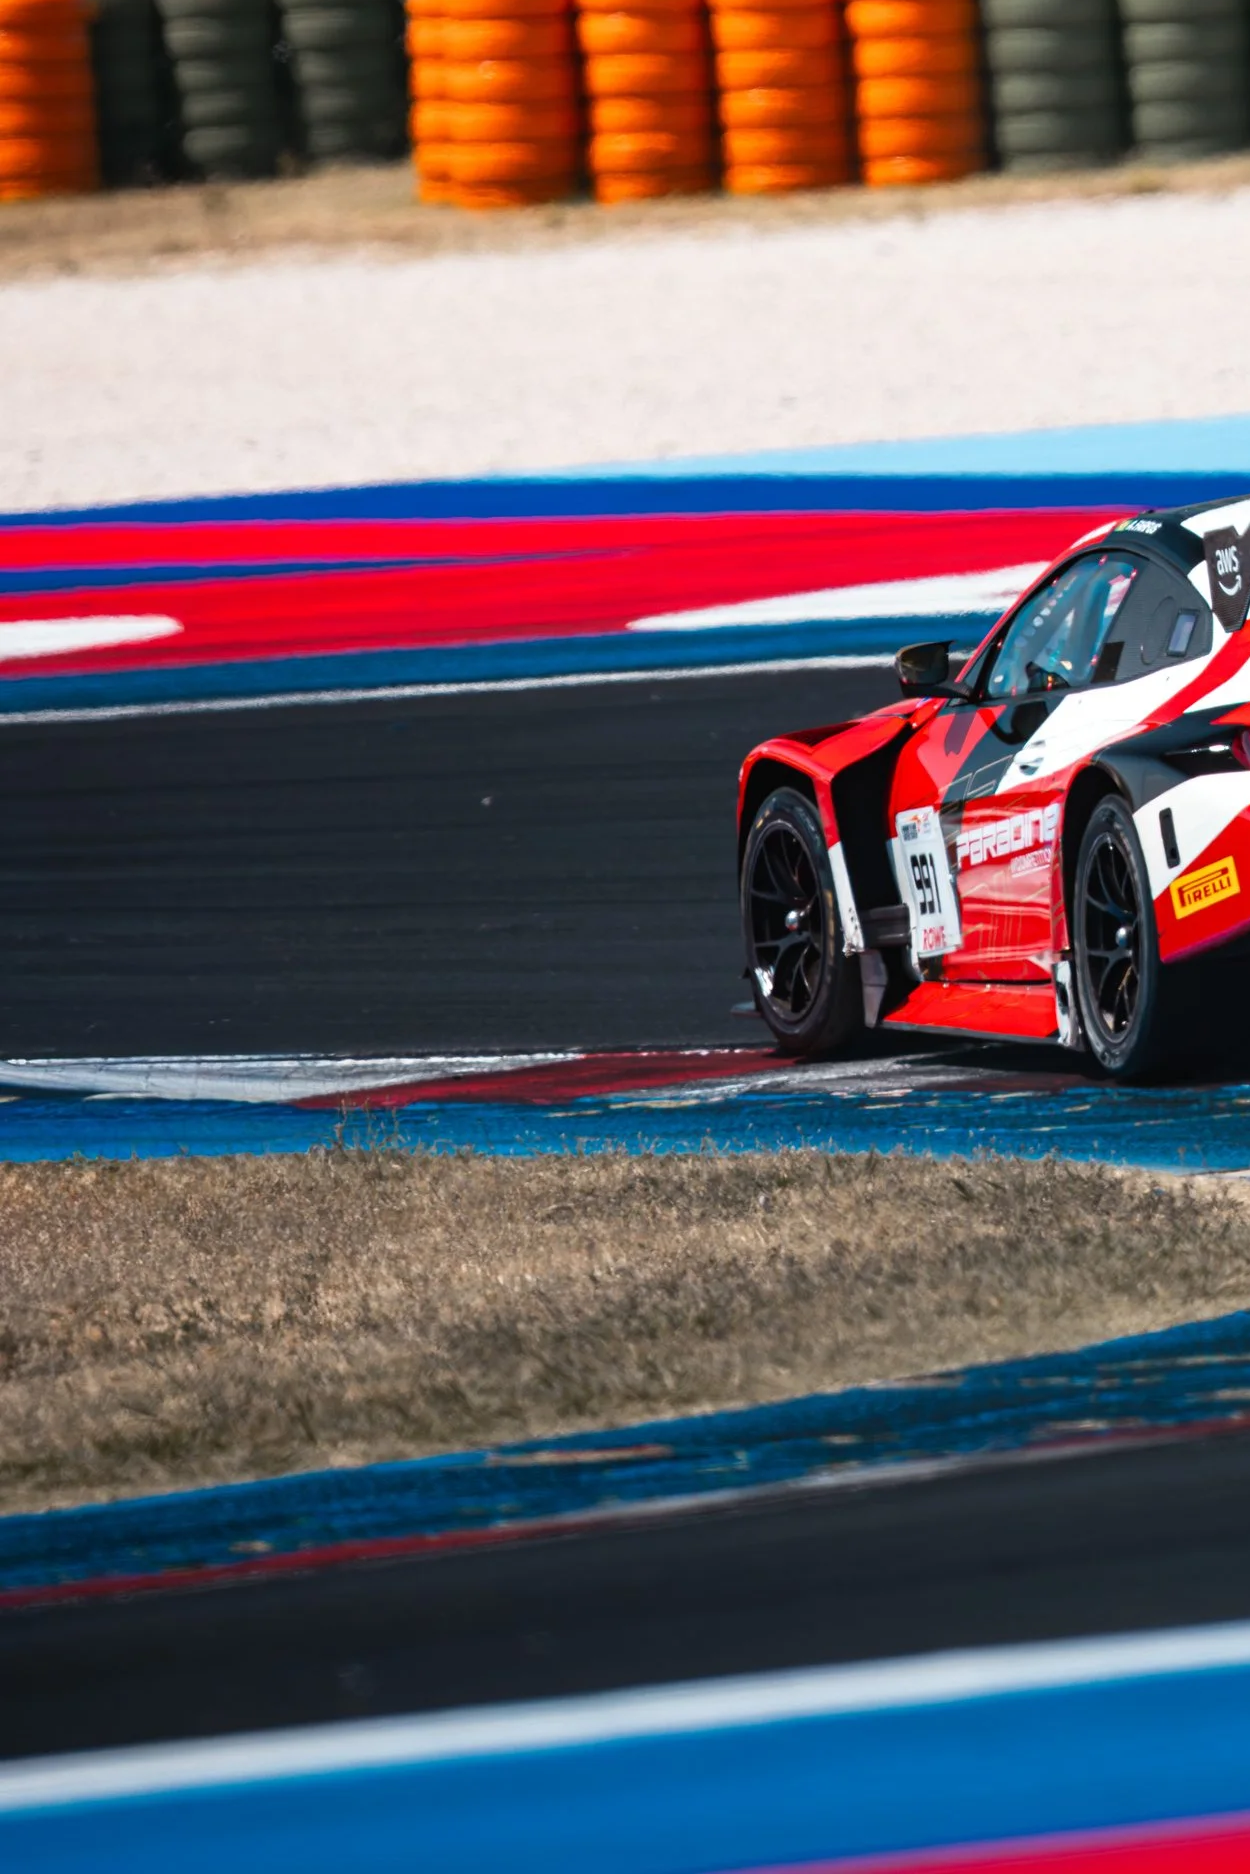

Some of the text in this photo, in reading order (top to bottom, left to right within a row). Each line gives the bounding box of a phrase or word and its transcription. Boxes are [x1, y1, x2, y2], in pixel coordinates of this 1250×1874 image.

[1215, 545, 1240, 576] aws
[911, 853, 941, 914] 991
[1178, 867, 1231, 907] PIRELLI
